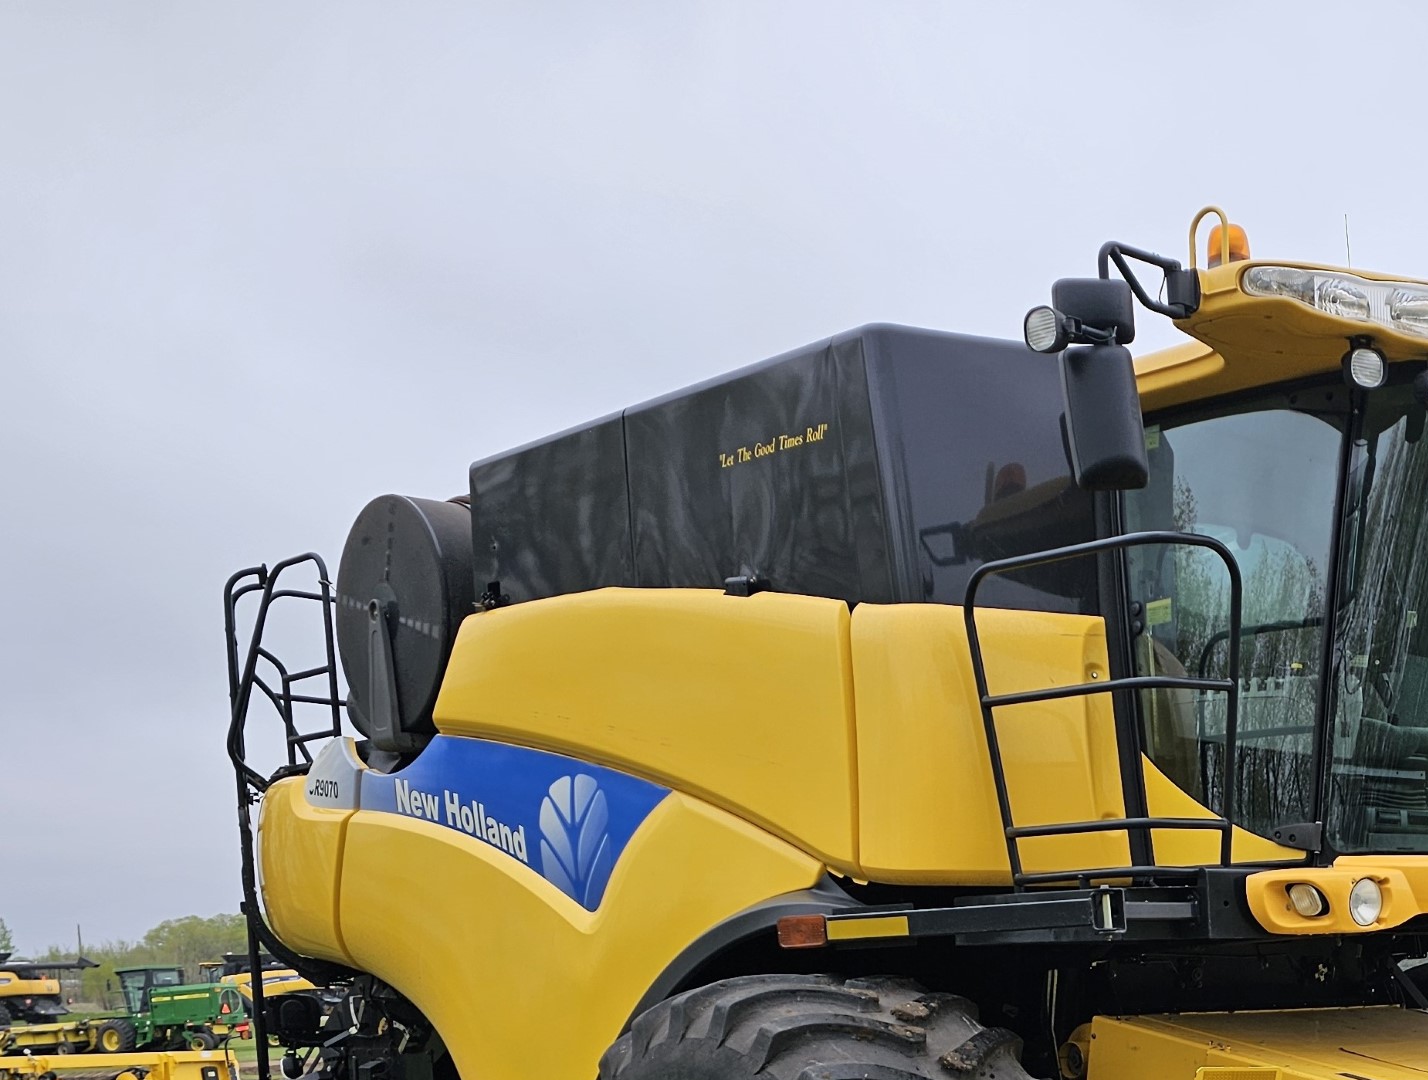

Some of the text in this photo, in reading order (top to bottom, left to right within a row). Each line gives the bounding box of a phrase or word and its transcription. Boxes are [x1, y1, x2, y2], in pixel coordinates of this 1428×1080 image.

[737, 446, 752, 463] The
[754, 438, 776, 458] Good
[778, 434, 803, 450] Times
[395, 778, 529, 864] New Holland
